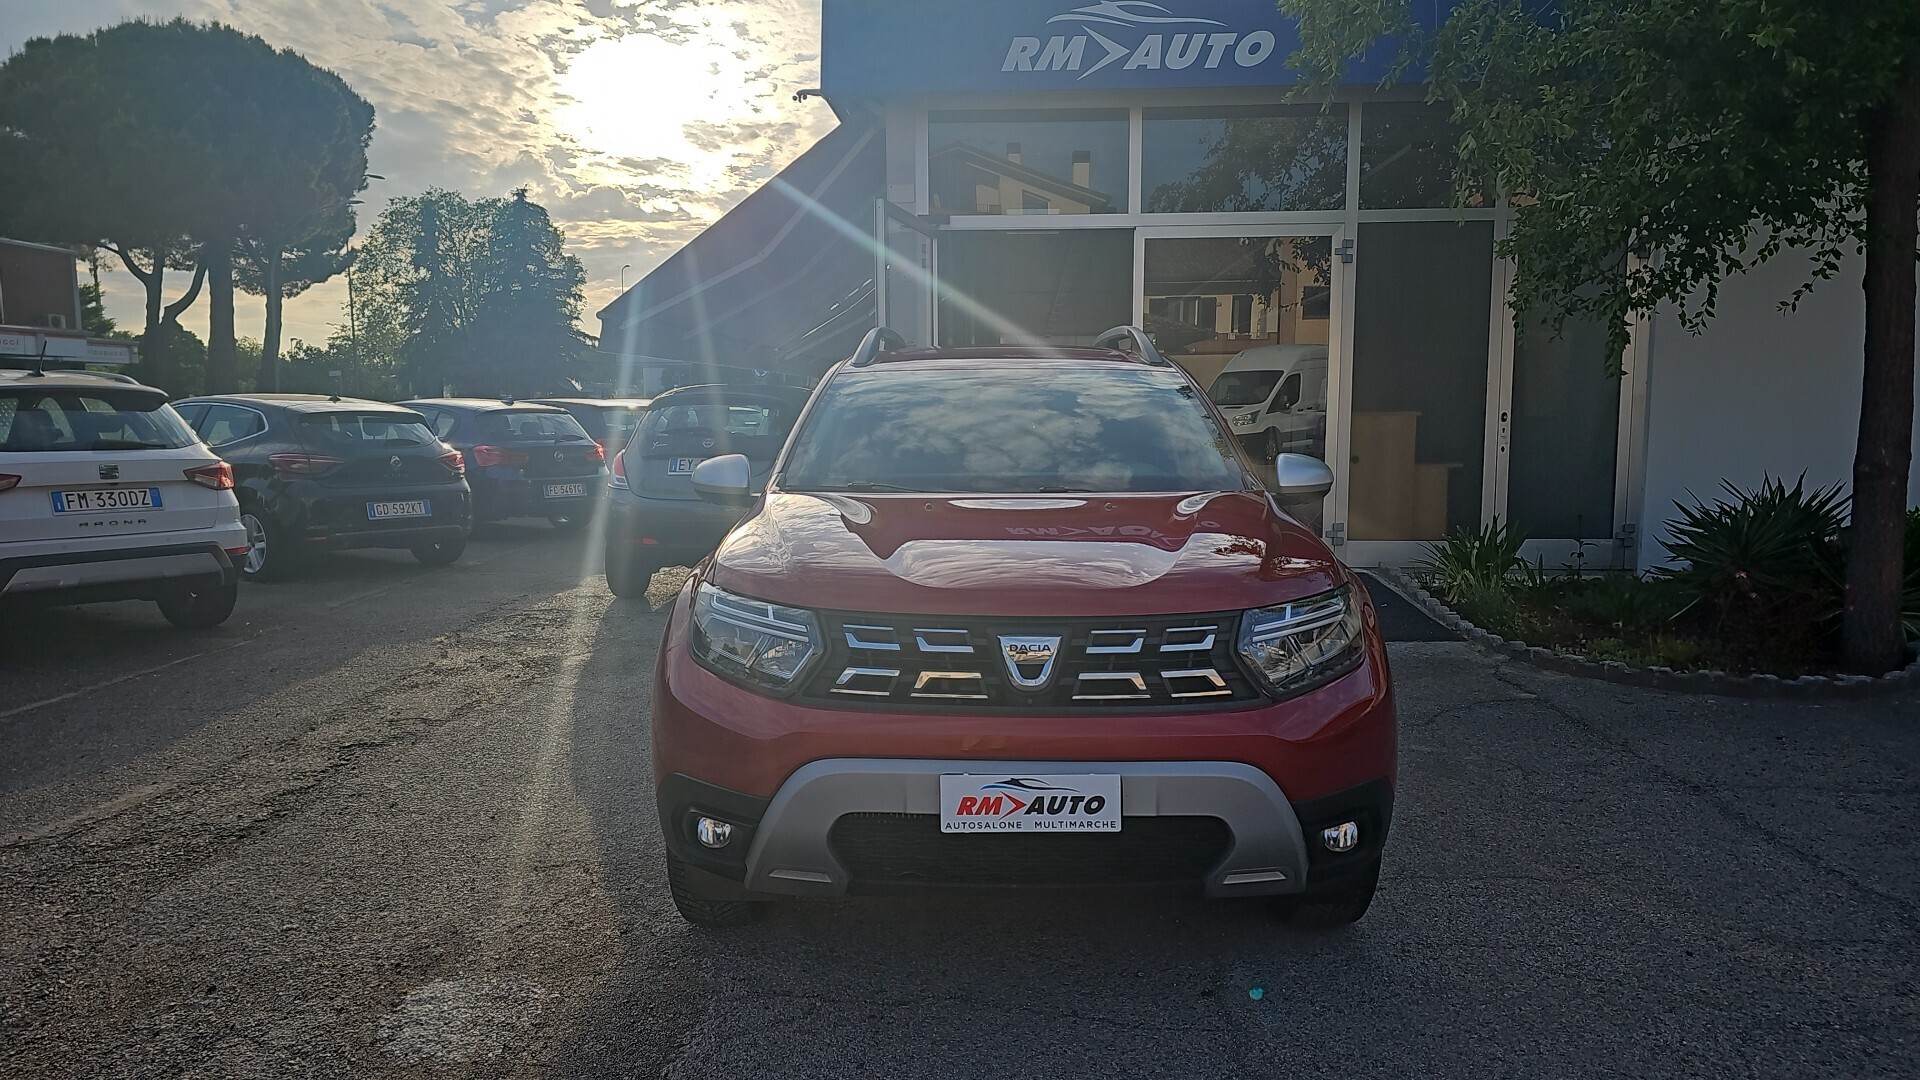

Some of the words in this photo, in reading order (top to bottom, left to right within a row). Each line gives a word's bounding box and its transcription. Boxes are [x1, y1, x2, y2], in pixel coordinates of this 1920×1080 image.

[1001, 35, 1087, 72] RM
[1122, 30, 1276, 70] AUTO
[94, 490, 151, 508] 330DZ
[78, 519, 147, 527] ARONA
[1009, 644, 1051, 652] DACIA
[956, 796, 1004, 816] RM
[1024, 796, 1106, 815] AUTO
[945, 821, 1023, 830] AUTOSALONE
[1034, 820, 1117, 829] MULTIMARCHE
